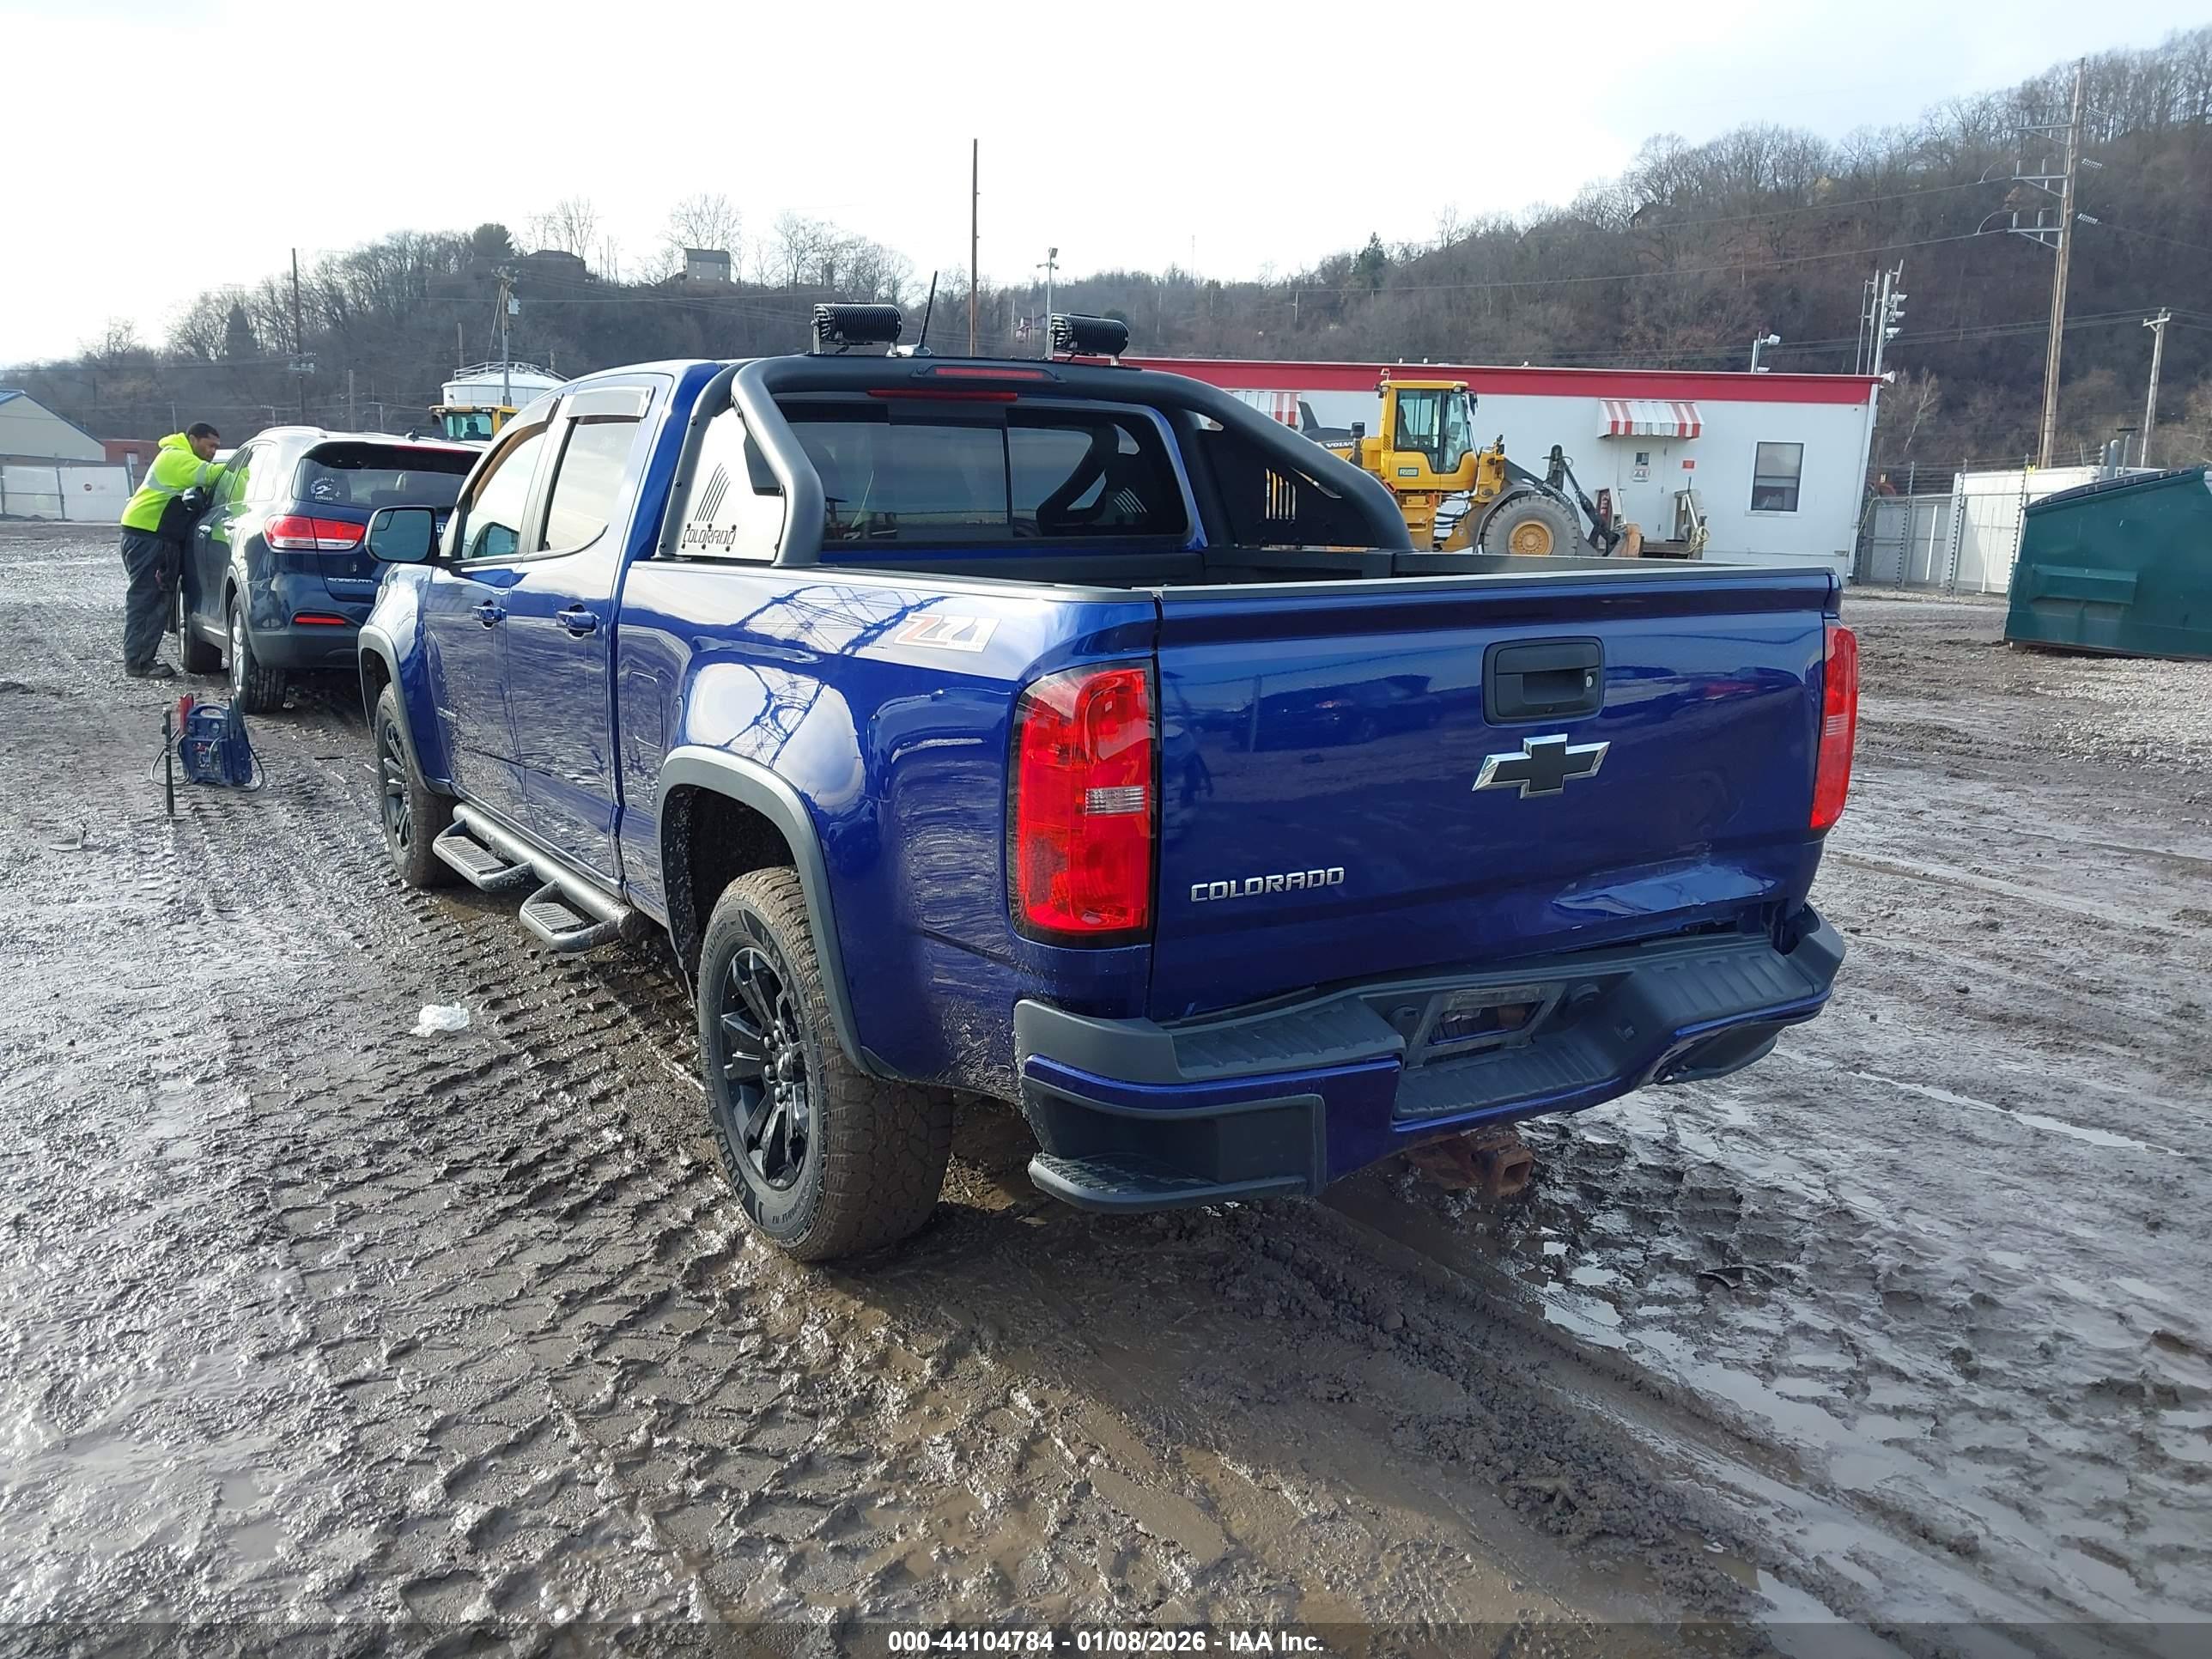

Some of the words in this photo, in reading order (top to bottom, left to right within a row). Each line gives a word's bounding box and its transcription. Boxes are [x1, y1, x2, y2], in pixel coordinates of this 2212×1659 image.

[683, 528, 736, 545] COLORADO
[893, 613, 1002, 653] Z71
[1191, 866, 1345, 902] COLORADO
